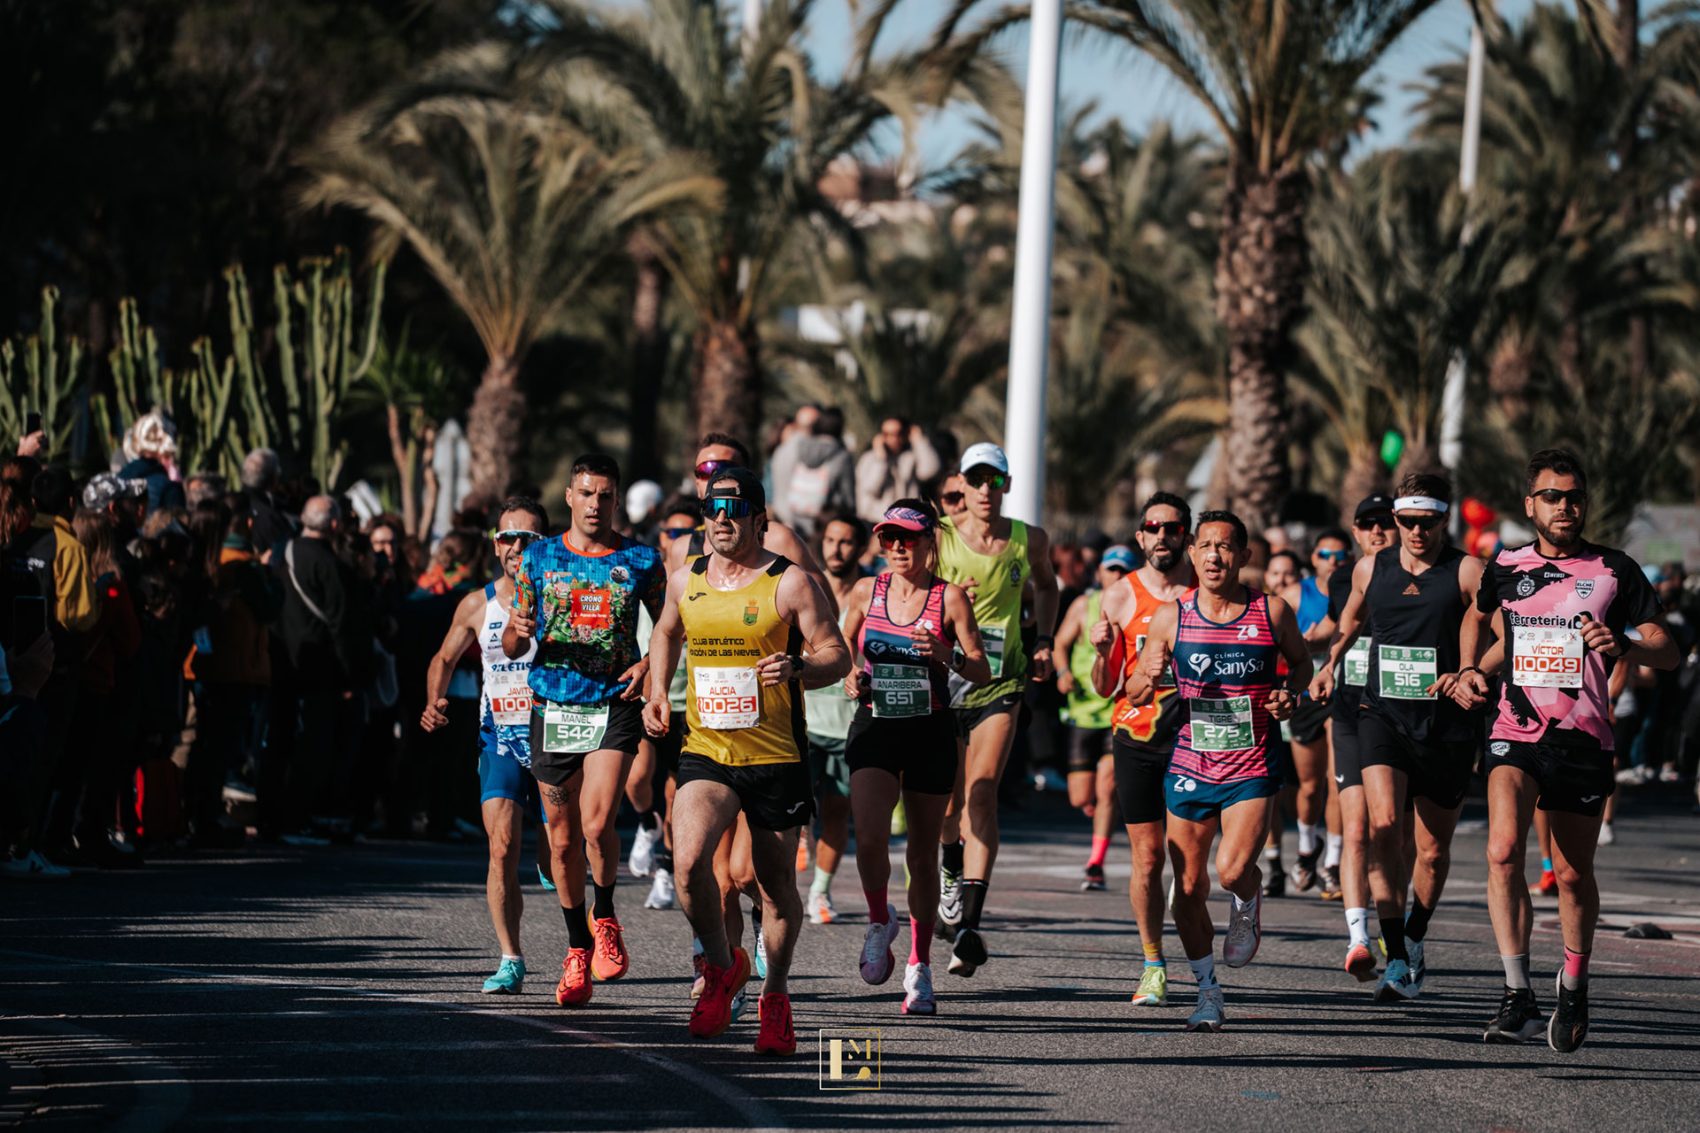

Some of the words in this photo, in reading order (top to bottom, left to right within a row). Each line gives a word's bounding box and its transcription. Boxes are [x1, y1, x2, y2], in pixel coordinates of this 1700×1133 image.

[1510, 612, 1566, 626] ferreteria
[1531, 644, 1564, 655] VÍCTOR
[1214, 658, 1265, 678] SanySa
[1399, 663, 1414, 671] OLA
[1518, 657, 1578, 673] 10049
[877, 680, 922, 689] ANARIBERA
[1394, 673, 1421, 687] 516
[709, 686, 736, 696] ALICIA
[886, 691, 913, 705] 651
[699, 697, 753, 713] 10026
[561, 713, 592, 724] MANEL
[557, 725, 598, 740] 544
[1204, 724, 1240, 738] 275
